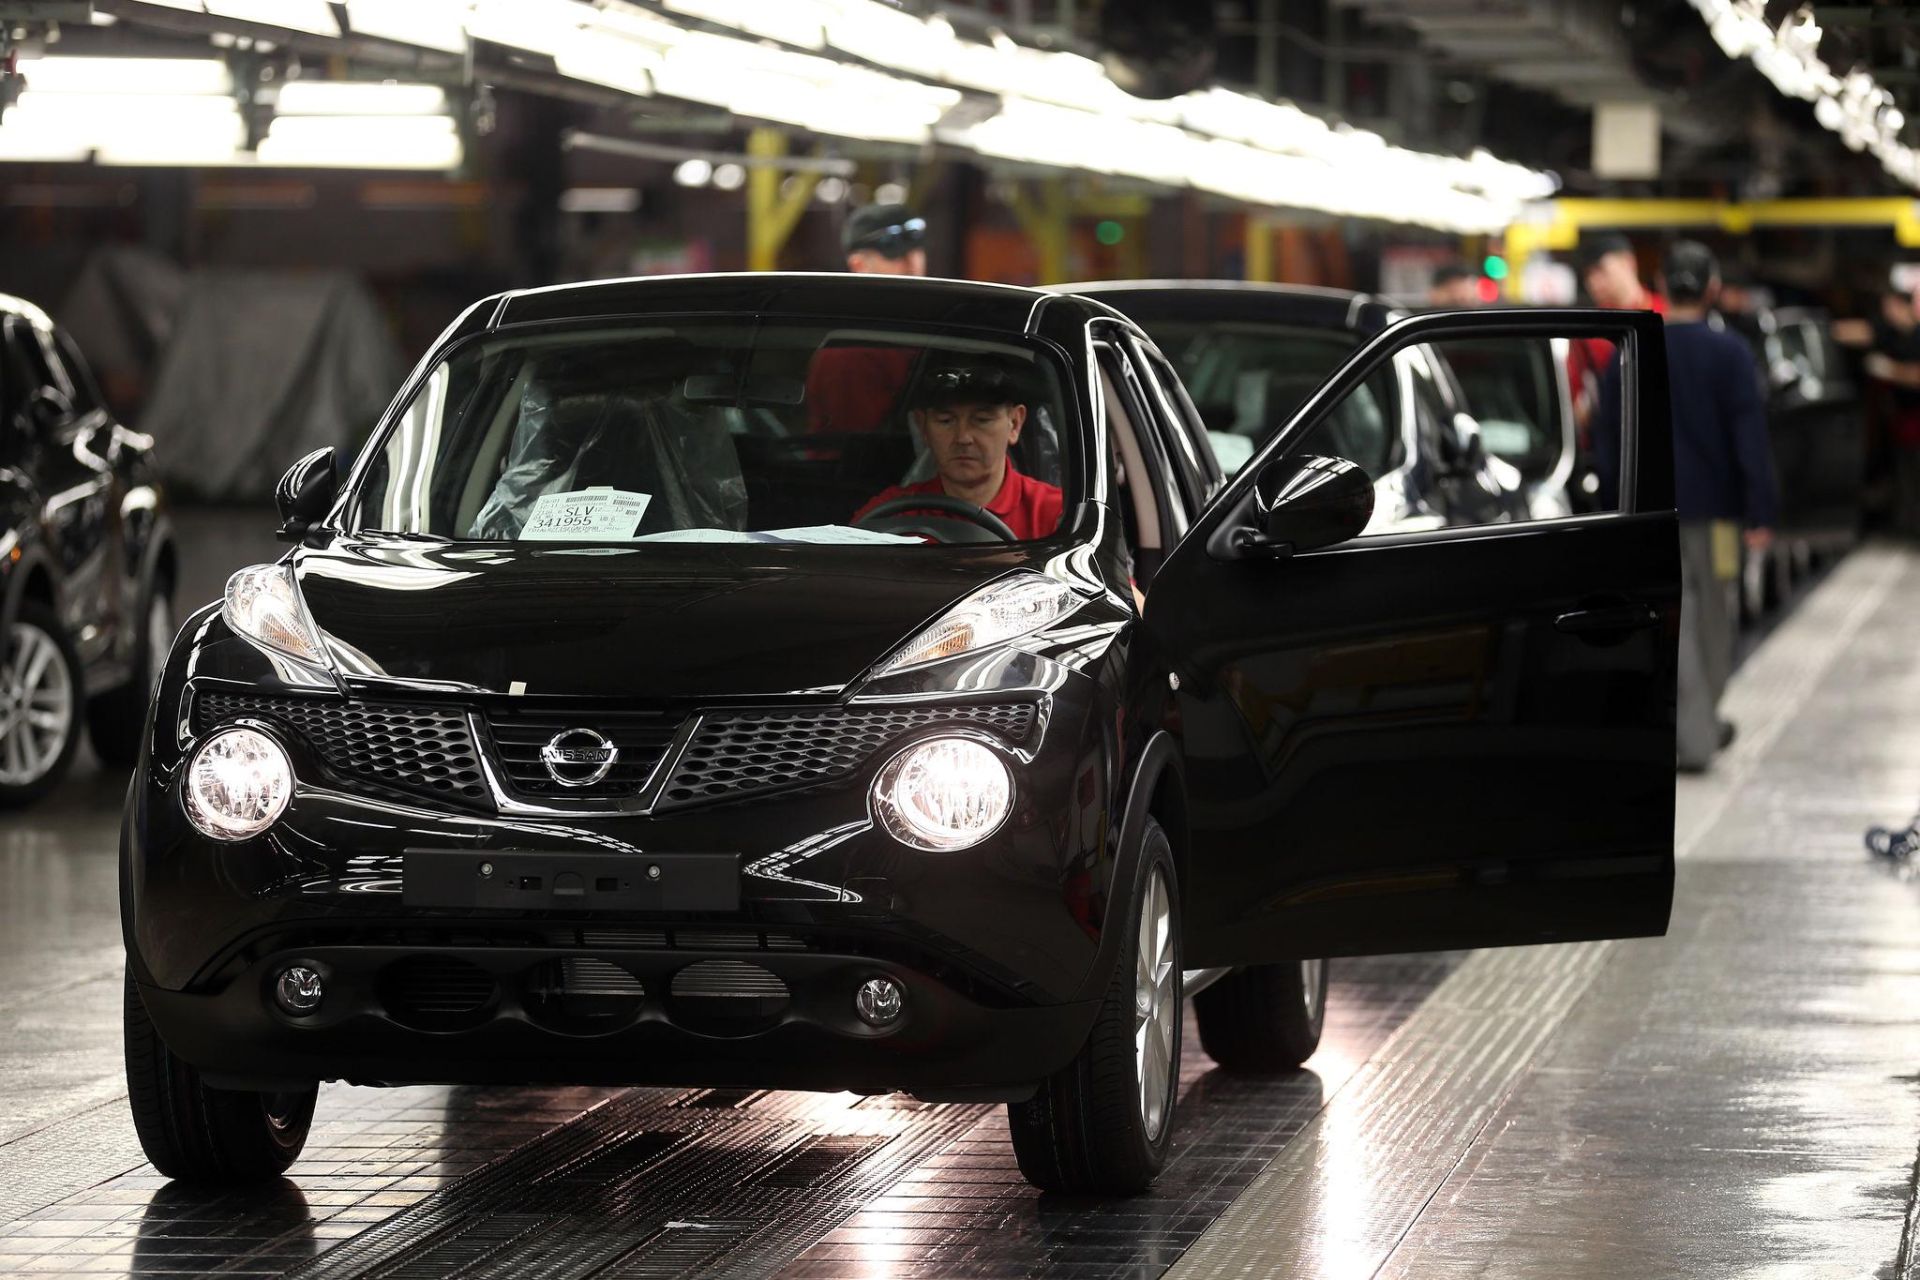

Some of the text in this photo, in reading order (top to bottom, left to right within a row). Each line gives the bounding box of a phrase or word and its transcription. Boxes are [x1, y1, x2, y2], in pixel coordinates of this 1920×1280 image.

[563, 505, 595, 517] SLV
[533, 516, 592, 528] 341955
[547, 749, 610, 760] NISSAN
